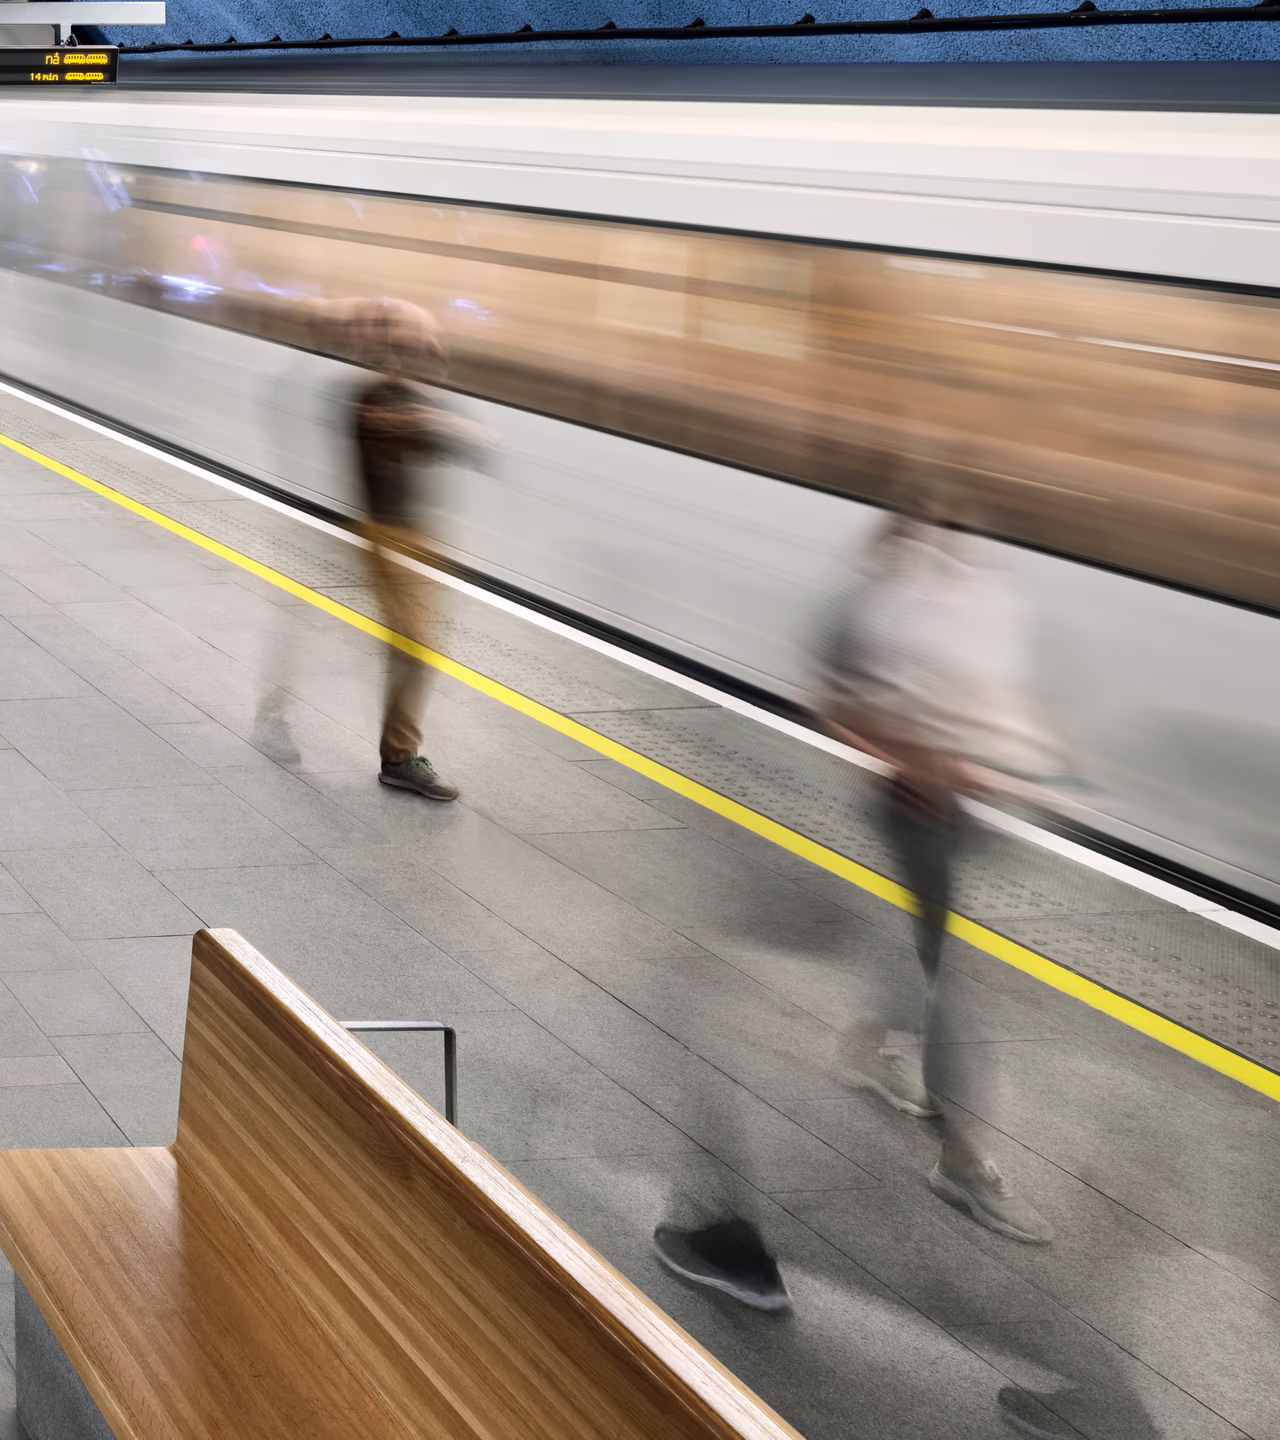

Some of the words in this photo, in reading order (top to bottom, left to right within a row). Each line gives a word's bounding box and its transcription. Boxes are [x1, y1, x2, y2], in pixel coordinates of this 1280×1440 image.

[45, 52, 60, 65] nå
[30, 72, 41, 81] 14
[42, 72, 59, 81] min
